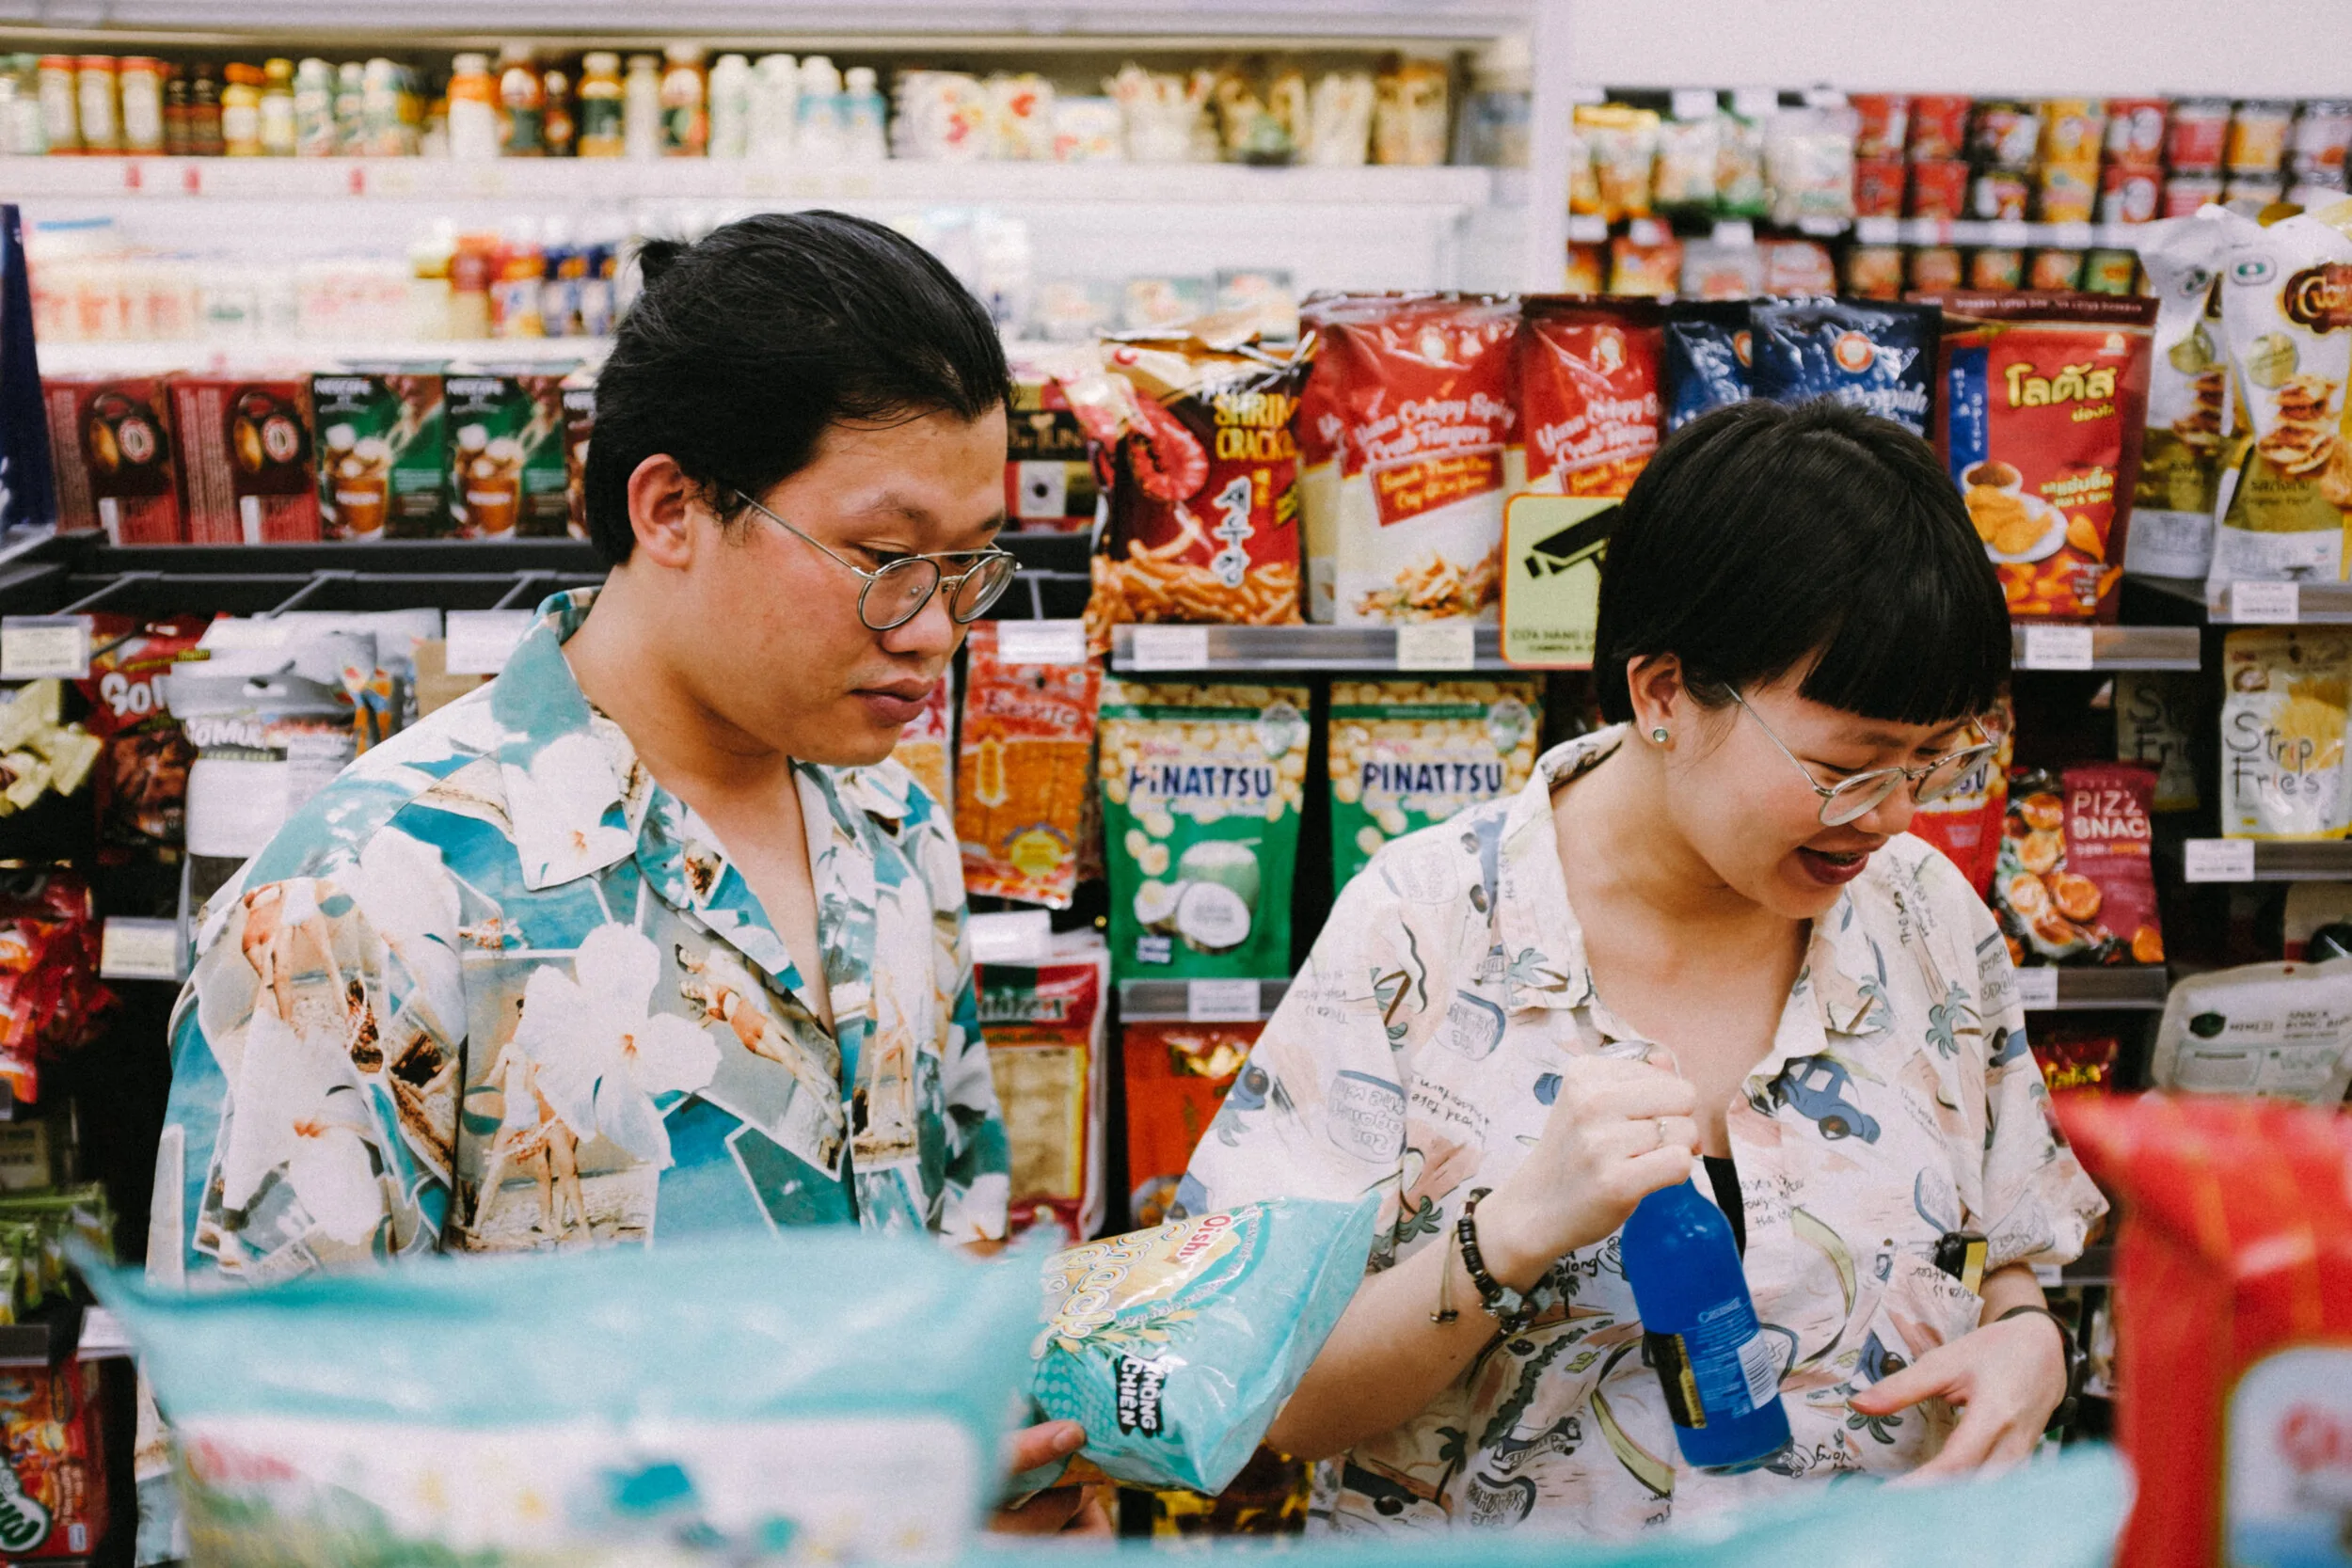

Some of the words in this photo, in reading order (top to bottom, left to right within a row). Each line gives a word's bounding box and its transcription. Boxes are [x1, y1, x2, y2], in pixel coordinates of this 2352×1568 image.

[1214, 392, 1300, 428] SHRIM
[1216, 427, 1296, 461] CRACK
[2225, 710, 2313, 779] Strip
[1361, 761, 1503, 794] PINATTSU
[2233, 755, 2320, 800] Fries
[2072, 789, 2143, 816] PIZZ
[1177, 1214, 1232, 1263] Oishi
[1554, 1258, 1597, 1277] along
